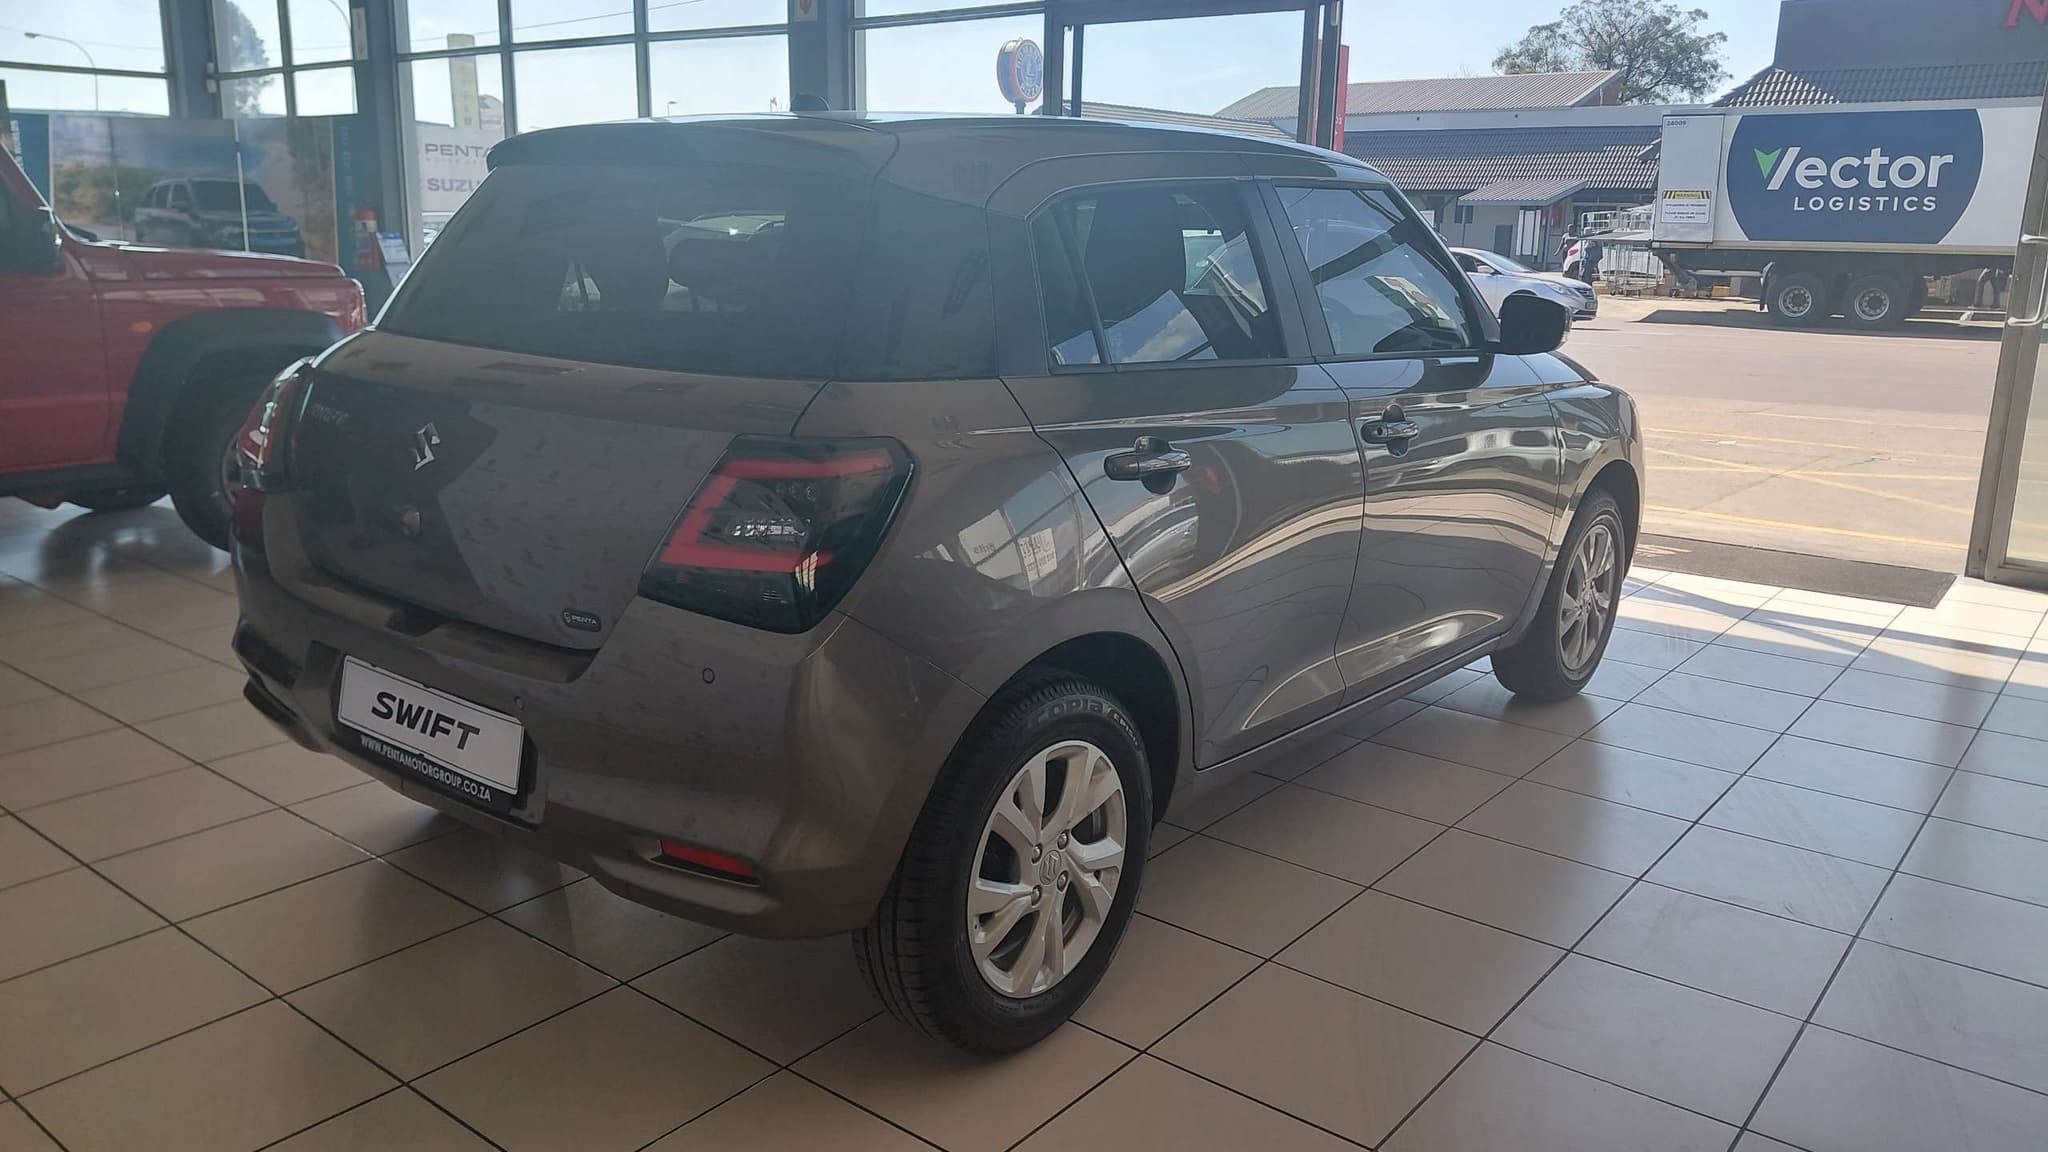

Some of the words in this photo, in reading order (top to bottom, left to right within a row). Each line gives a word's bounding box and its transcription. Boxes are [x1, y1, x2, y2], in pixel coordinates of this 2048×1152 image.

[1753, 147, 1954, 191] Vector
[1793, 196, 1937, 212] LOGISTICS
[571, 615, 597, 625] PENTA
[371, 691, 480, 750] SWIFT
[360, 735, 492, 802] WWW.PENTAMOTORGROUP.CO.ZA
